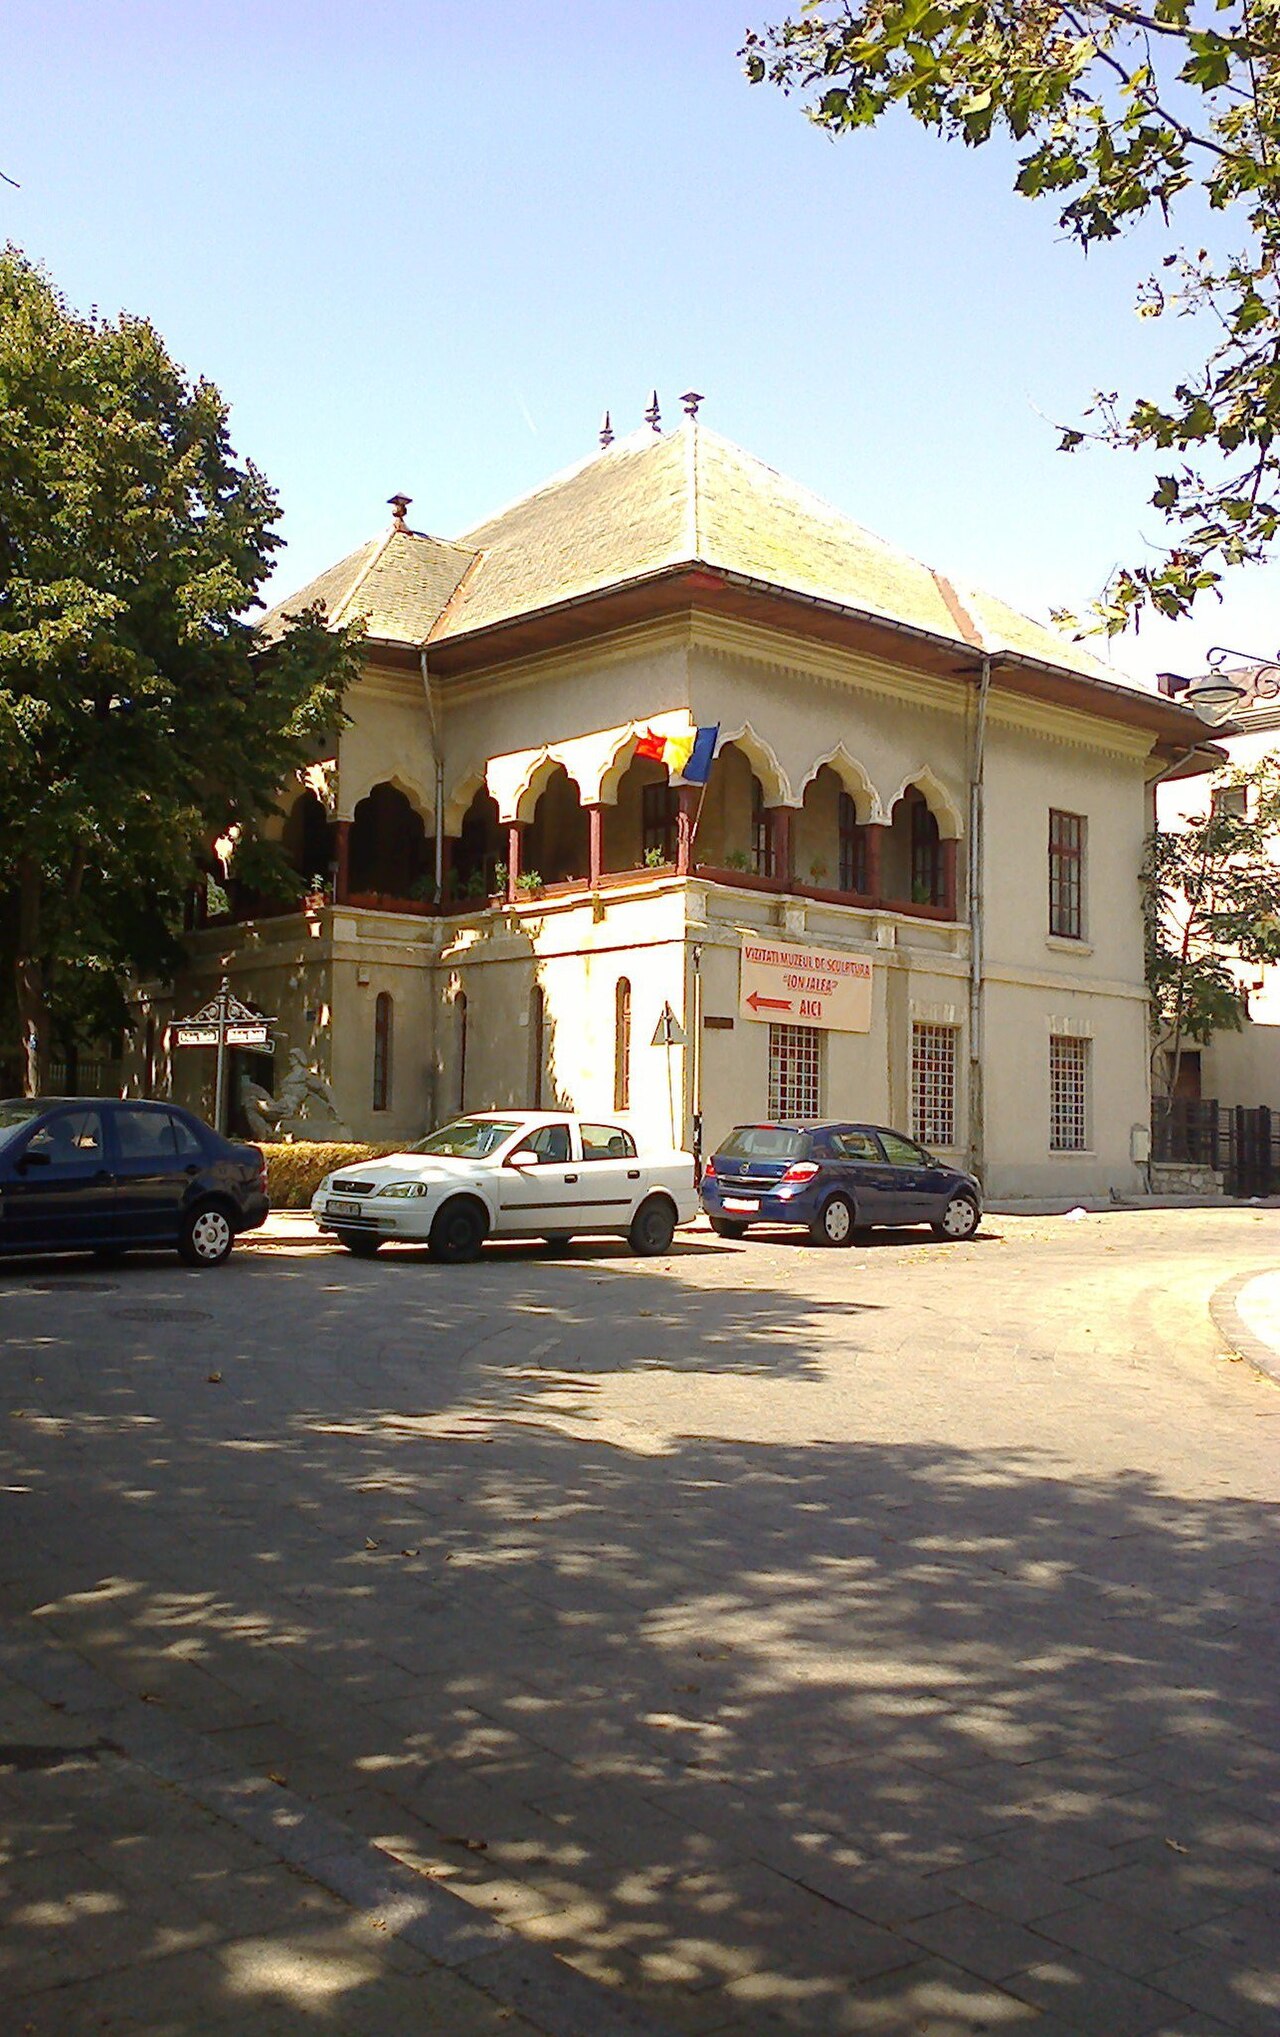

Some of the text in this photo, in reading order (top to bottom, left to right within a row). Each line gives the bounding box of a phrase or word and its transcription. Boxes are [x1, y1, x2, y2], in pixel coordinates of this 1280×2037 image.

[780, 952, 814, 968] MUZEUL
[815, 957, 826, 970] DE
[799, 999, 822, 1016] AICI
